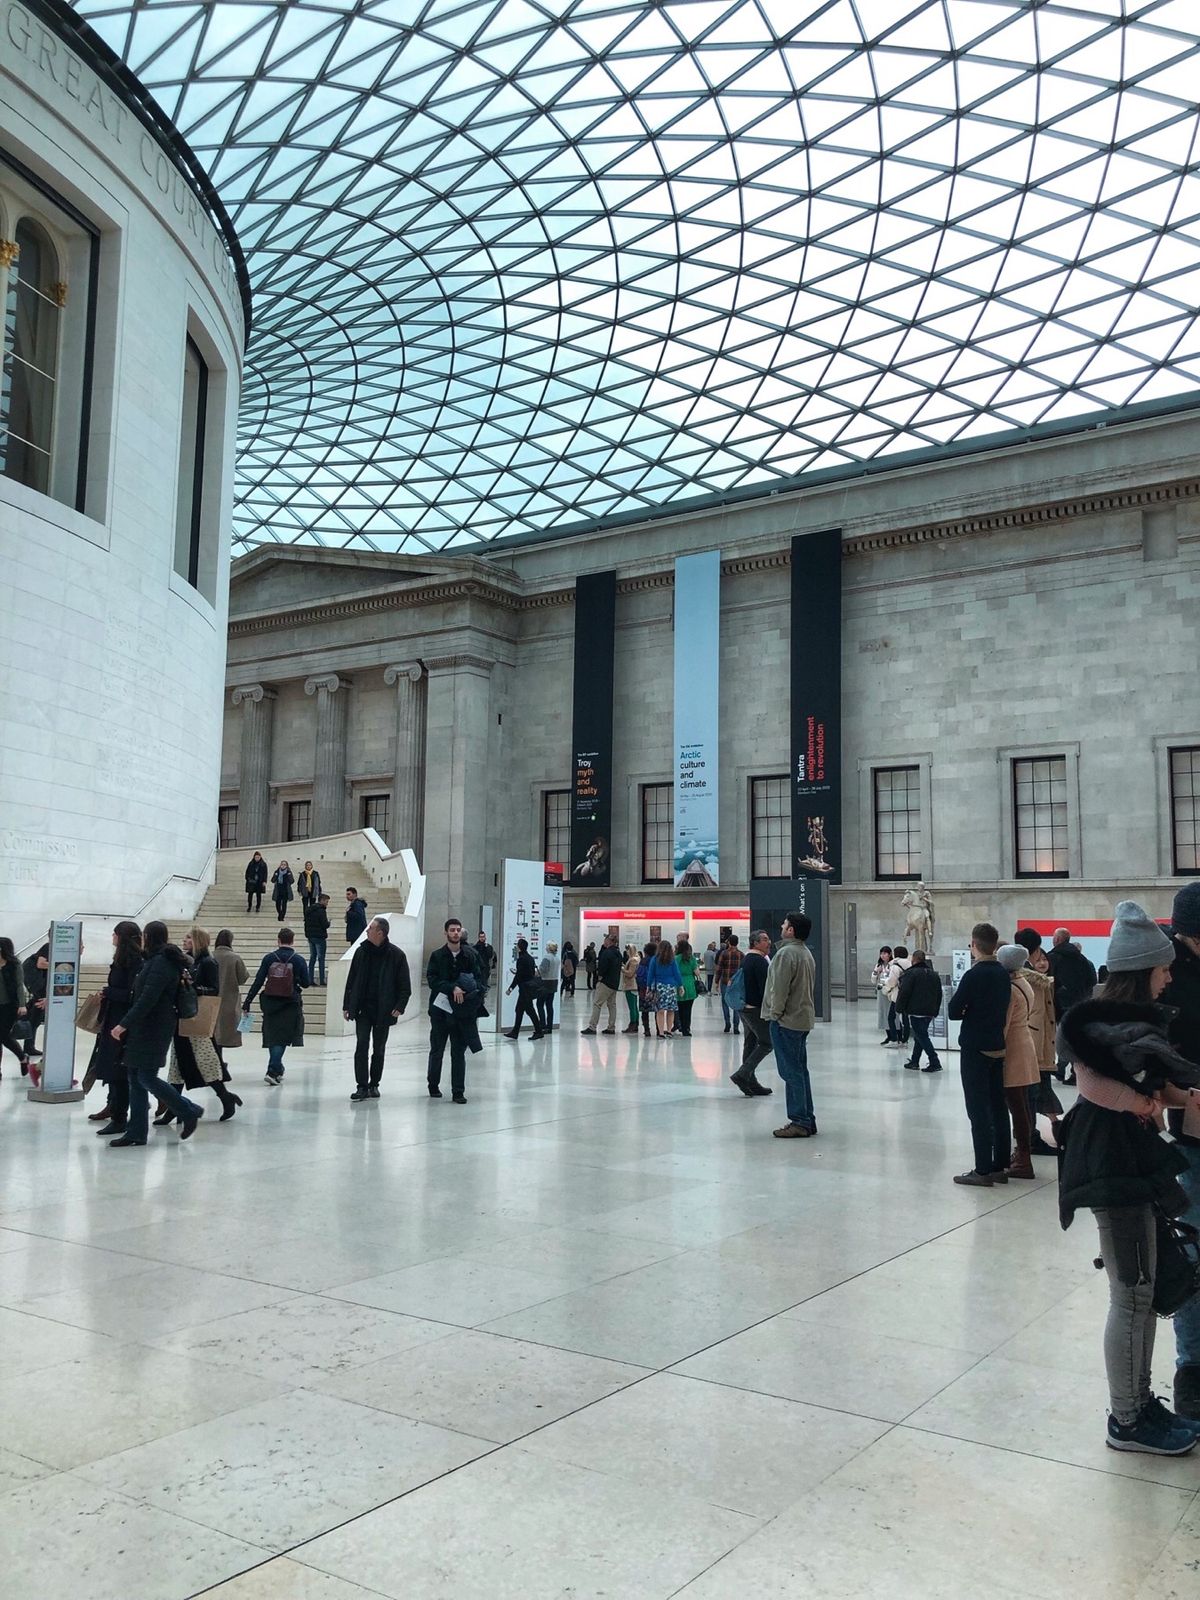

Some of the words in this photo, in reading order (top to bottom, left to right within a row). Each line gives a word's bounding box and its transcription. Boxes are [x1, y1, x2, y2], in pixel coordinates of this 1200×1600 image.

[6, 4, 128, 145] GREAT
[138, 132, 209, 250] COURT
[806, 716, 815, 781] enlightenment
[816, 723, 824, 768] revolution
[680, 751, 702, 759] Arctic
[577, 759, 592, 768] Troy
[680, 760, 706, 769] culture
[577, 768, 594, 778] myth
[797, 754, 805, 783] Tantra
[680, 771, 694, 779] and
[816, 770, 824, 780] to
[680, 780, 707, 789] climate
[576, 787, 598, 796] reality
[800, 883, 806, 892] on
